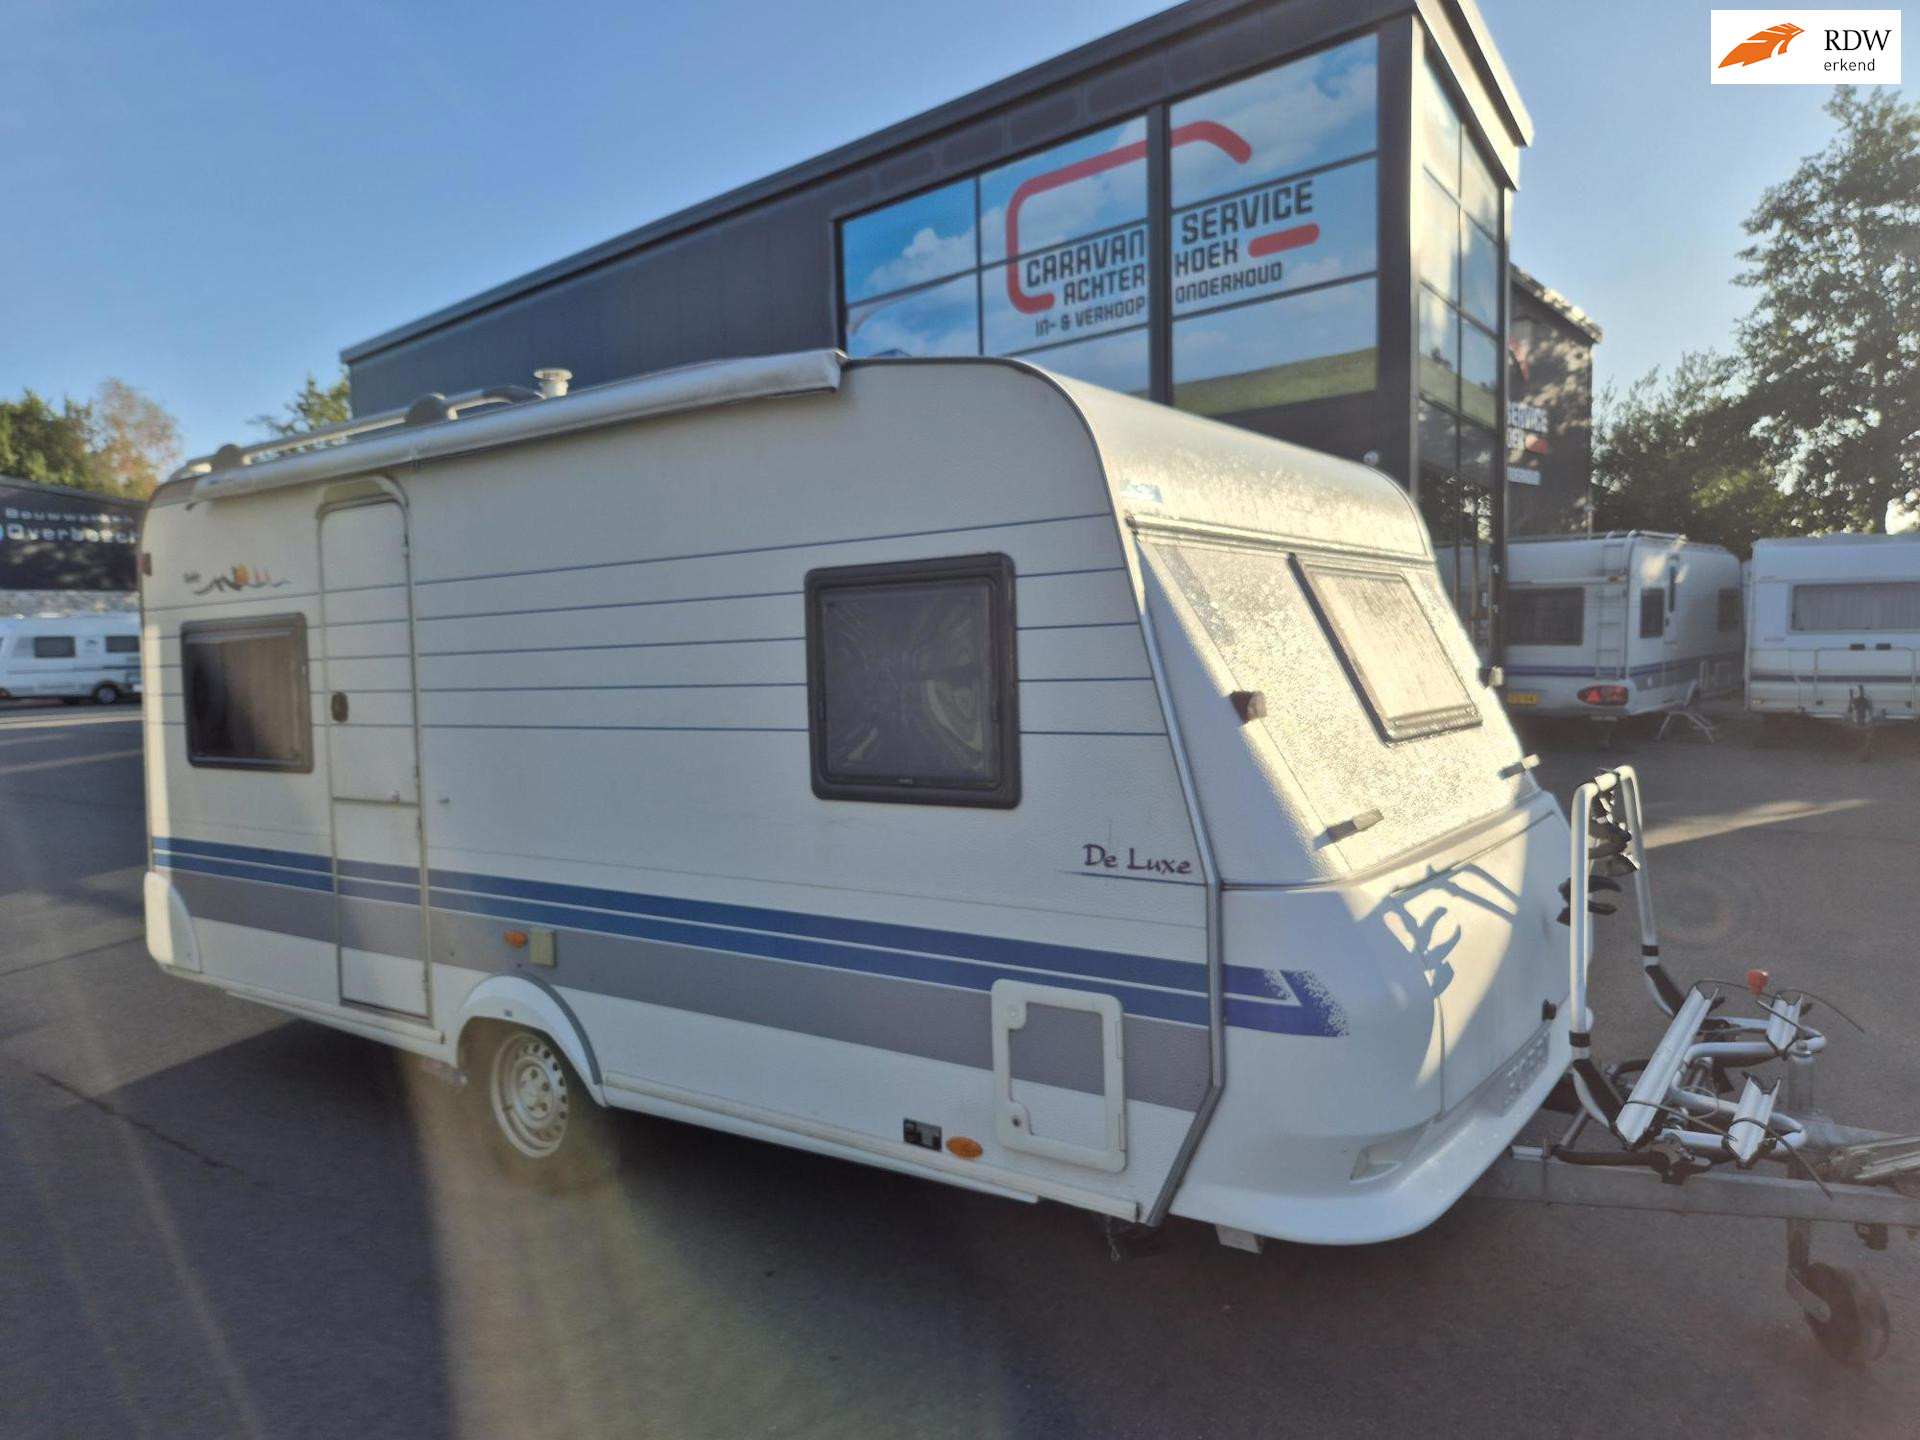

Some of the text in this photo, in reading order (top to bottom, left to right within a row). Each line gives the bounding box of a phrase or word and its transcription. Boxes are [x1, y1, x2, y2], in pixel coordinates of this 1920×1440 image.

[1026, 180, 1312, 288] CARAVAN SERVICE
[1063, 238, 1238, 307] ACHTER HOEK
[1075, 296, 1145, 328] VERKOOP
[1175, 261, 1282, 304] ONDERHOUD
[1082, 843, 1192, 874] De Luxe
